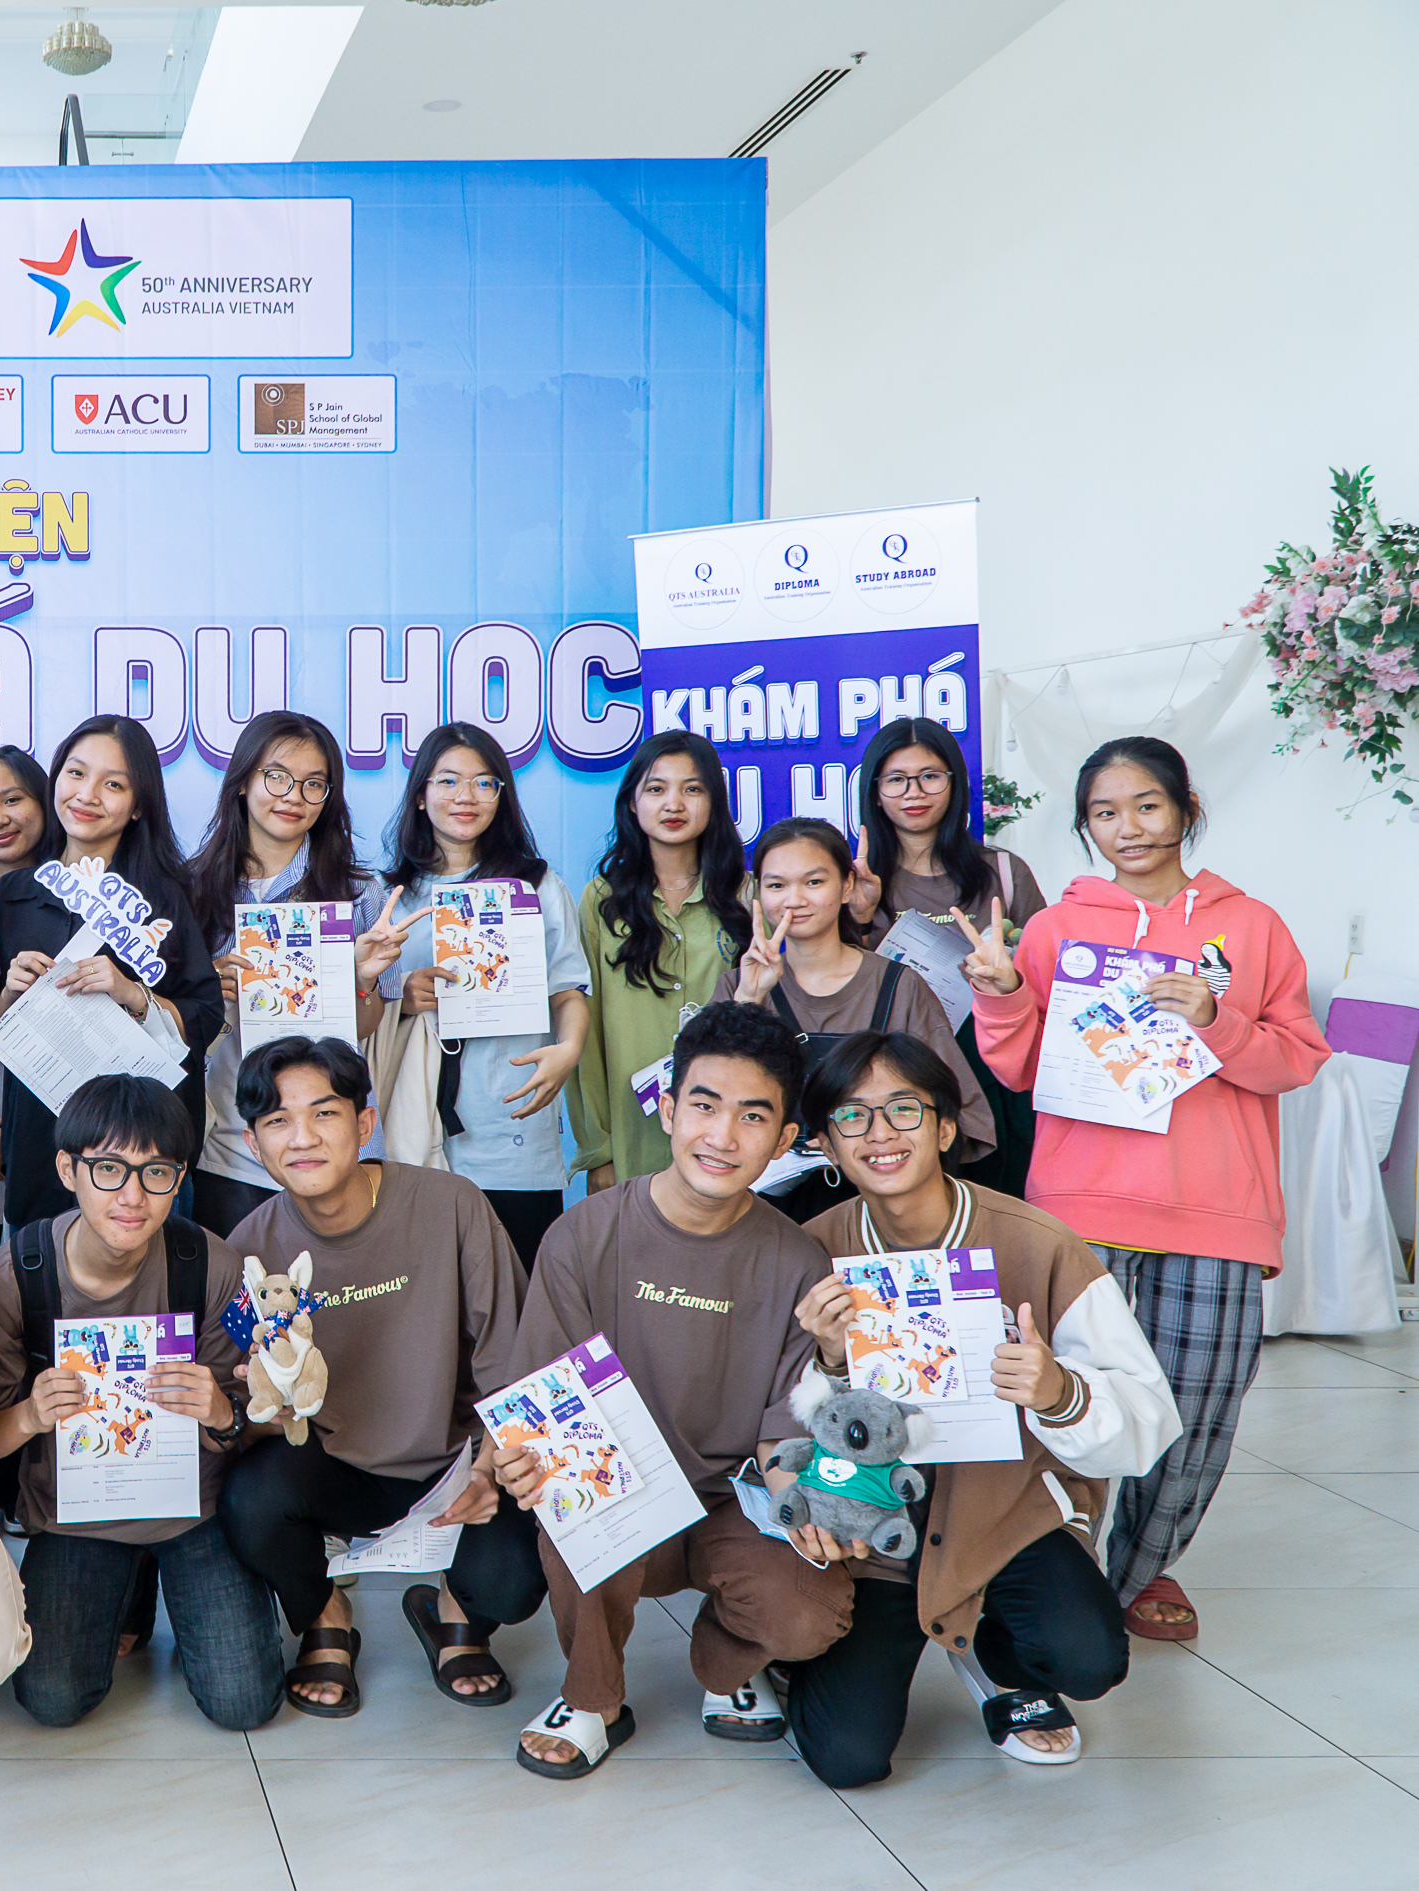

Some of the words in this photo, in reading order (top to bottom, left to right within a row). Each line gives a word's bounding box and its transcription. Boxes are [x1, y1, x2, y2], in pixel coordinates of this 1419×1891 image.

[141, 276, 175, 294] 50th
[179, 276, 313, 294] ANNIVERSARY
[141, 301, 225, 315] AUSTRALIA
[229, 301, 294, 315] VIETNAM
[104, 394, 188, 425] ACU
[309, 403, 315, 411] S
[317, 403, 323, 411] P
[325, 403, 343, 411] Jain
[276, 419, 305, 435] SPJ
[309, 414, 339, 423] School
[341, 414, 350, 423] of
[352, 414, 382, 423] Global
[309, 426, 368, 436] Management
[855, 571, 890, 584] STUDY
[893, 567, 937, 580] ABROAD
[774, 578, 820, 591] DIPLOMA
[668, 591, 686, 602] QTS
[689, 587, 741, 600] AUSTRALIA
[92, 625, 289, 770] DU
[652, 665, 820, 747] KHÁM
[839, 652, 968, 744] PHÁ
[99, 875, 149, 925] QTS
[37, 862, 165, 985] AUSTRALIA
[1104, 955, 1140, 969] KHÁM
[1142, 961, 1167, 973] PHÁ
[634, 1280, 665, 1303] The
[1023, 1700, 1039, 1713] THE
